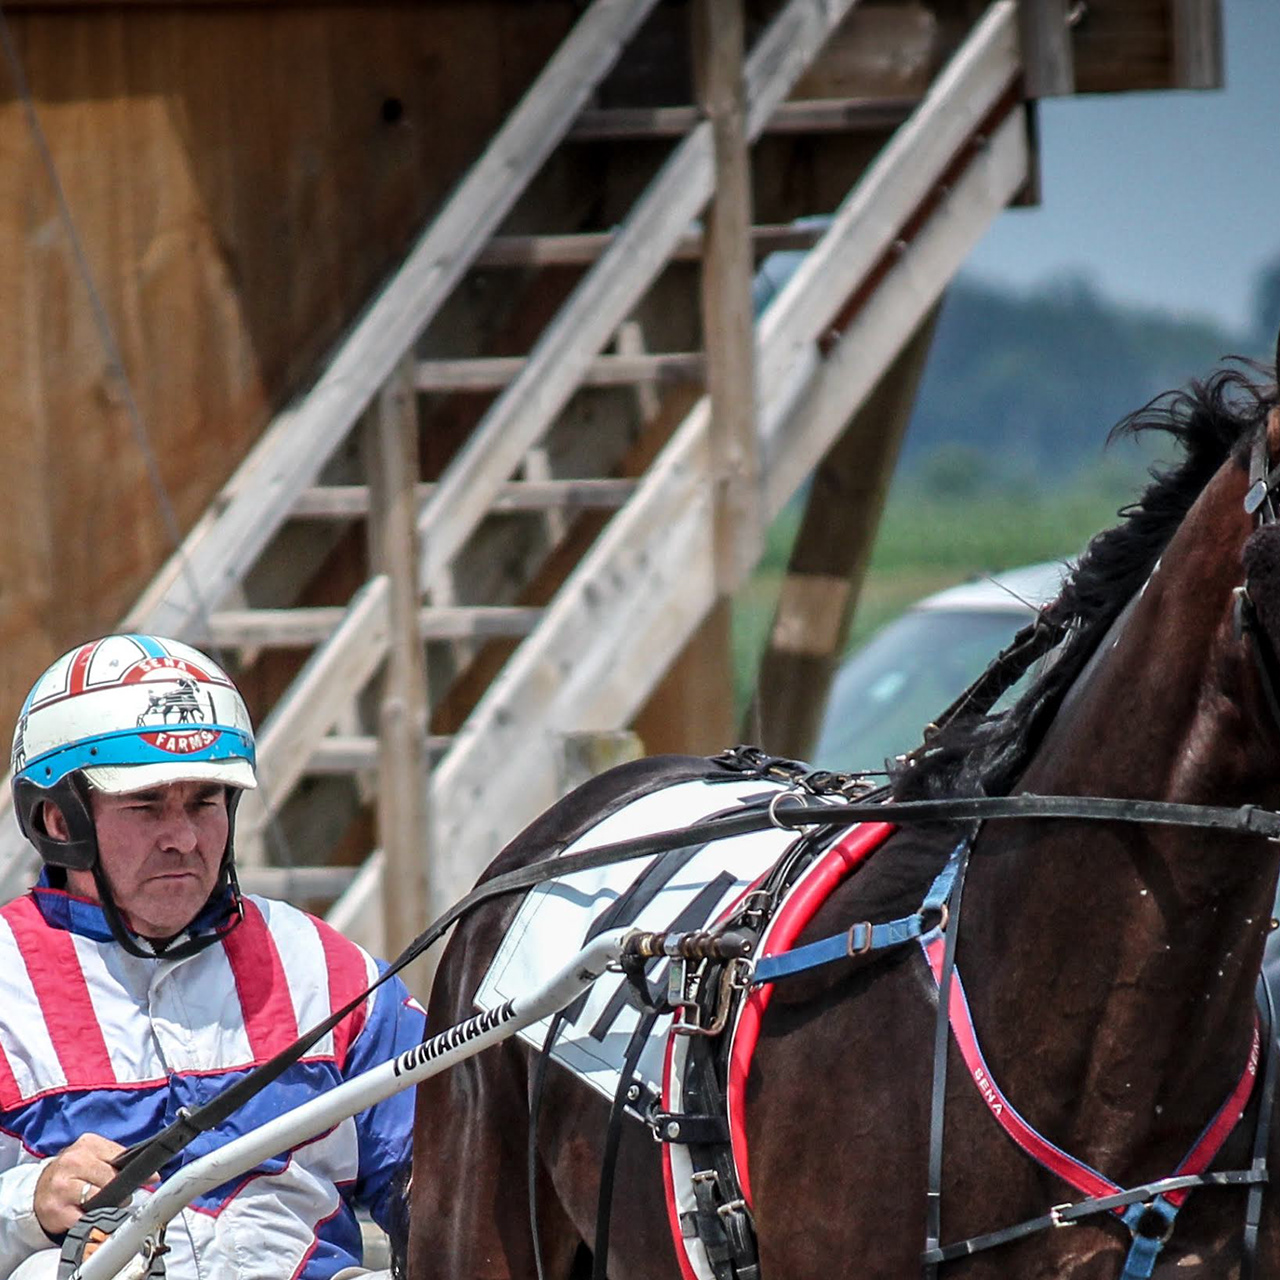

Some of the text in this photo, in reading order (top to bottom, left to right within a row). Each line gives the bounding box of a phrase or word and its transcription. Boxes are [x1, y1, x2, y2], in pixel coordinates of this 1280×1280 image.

[139, 658, 187, 672] SENA
[156, 731, 215, 751] FARMS
[974, 1068, 1003, 1115] SENA
